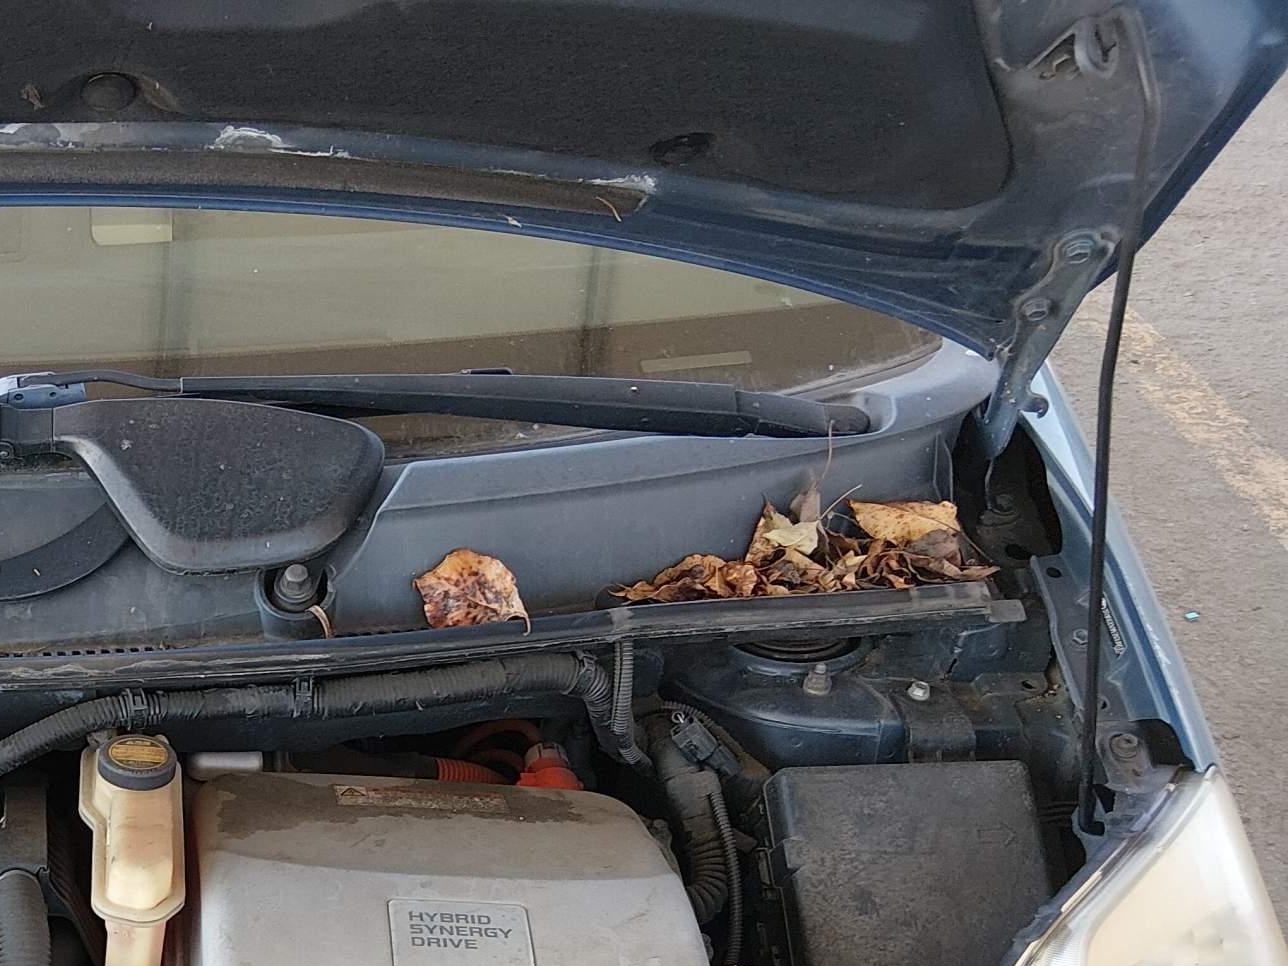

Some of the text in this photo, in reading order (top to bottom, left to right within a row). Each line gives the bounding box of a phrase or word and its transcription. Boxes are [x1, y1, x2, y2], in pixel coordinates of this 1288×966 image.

[408, 910, 492, 925] HYBRID
[409, 923, 513, 939] SYNERGY
[411, 936, 479, 950] DRIVE
